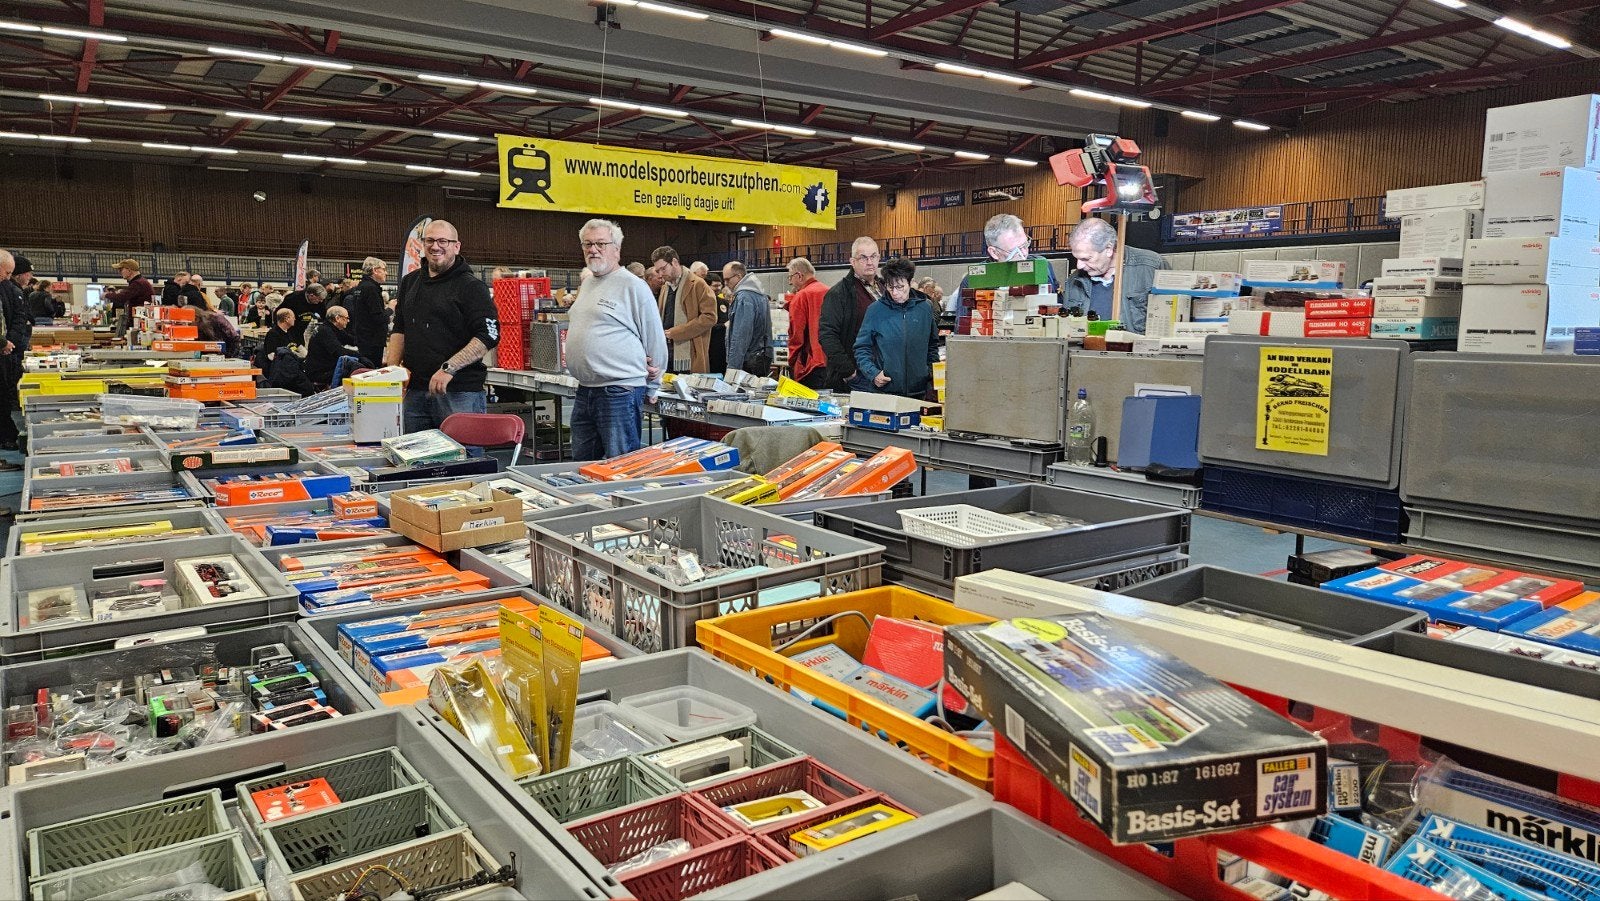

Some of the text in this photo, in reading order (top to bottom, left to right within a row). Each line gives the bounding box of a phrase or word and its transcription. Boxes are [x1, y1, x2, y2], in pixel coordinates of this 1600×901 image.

[564, 157, 802, 195] www.modelspoorbeurszutphen.com
[634, 190, 736, 212] Een gezellig dagje uit!
[257, 490, 279, 498] Roco
[798, 653, 831, 669] ärklin
[866, 678, 909, 701] märklin
[1151, 770, 1180, 786] 1:87
[1195, 762, 1241, 780] 161697
[1263, 760, 1296, 773] FALLER
[1273, 773, 1300, 795] car
[1263, 789, 1312, 814] system
[1126, 798, 1241, 835] Basis-Set
[1486, 808, 1600, 866] märkl
